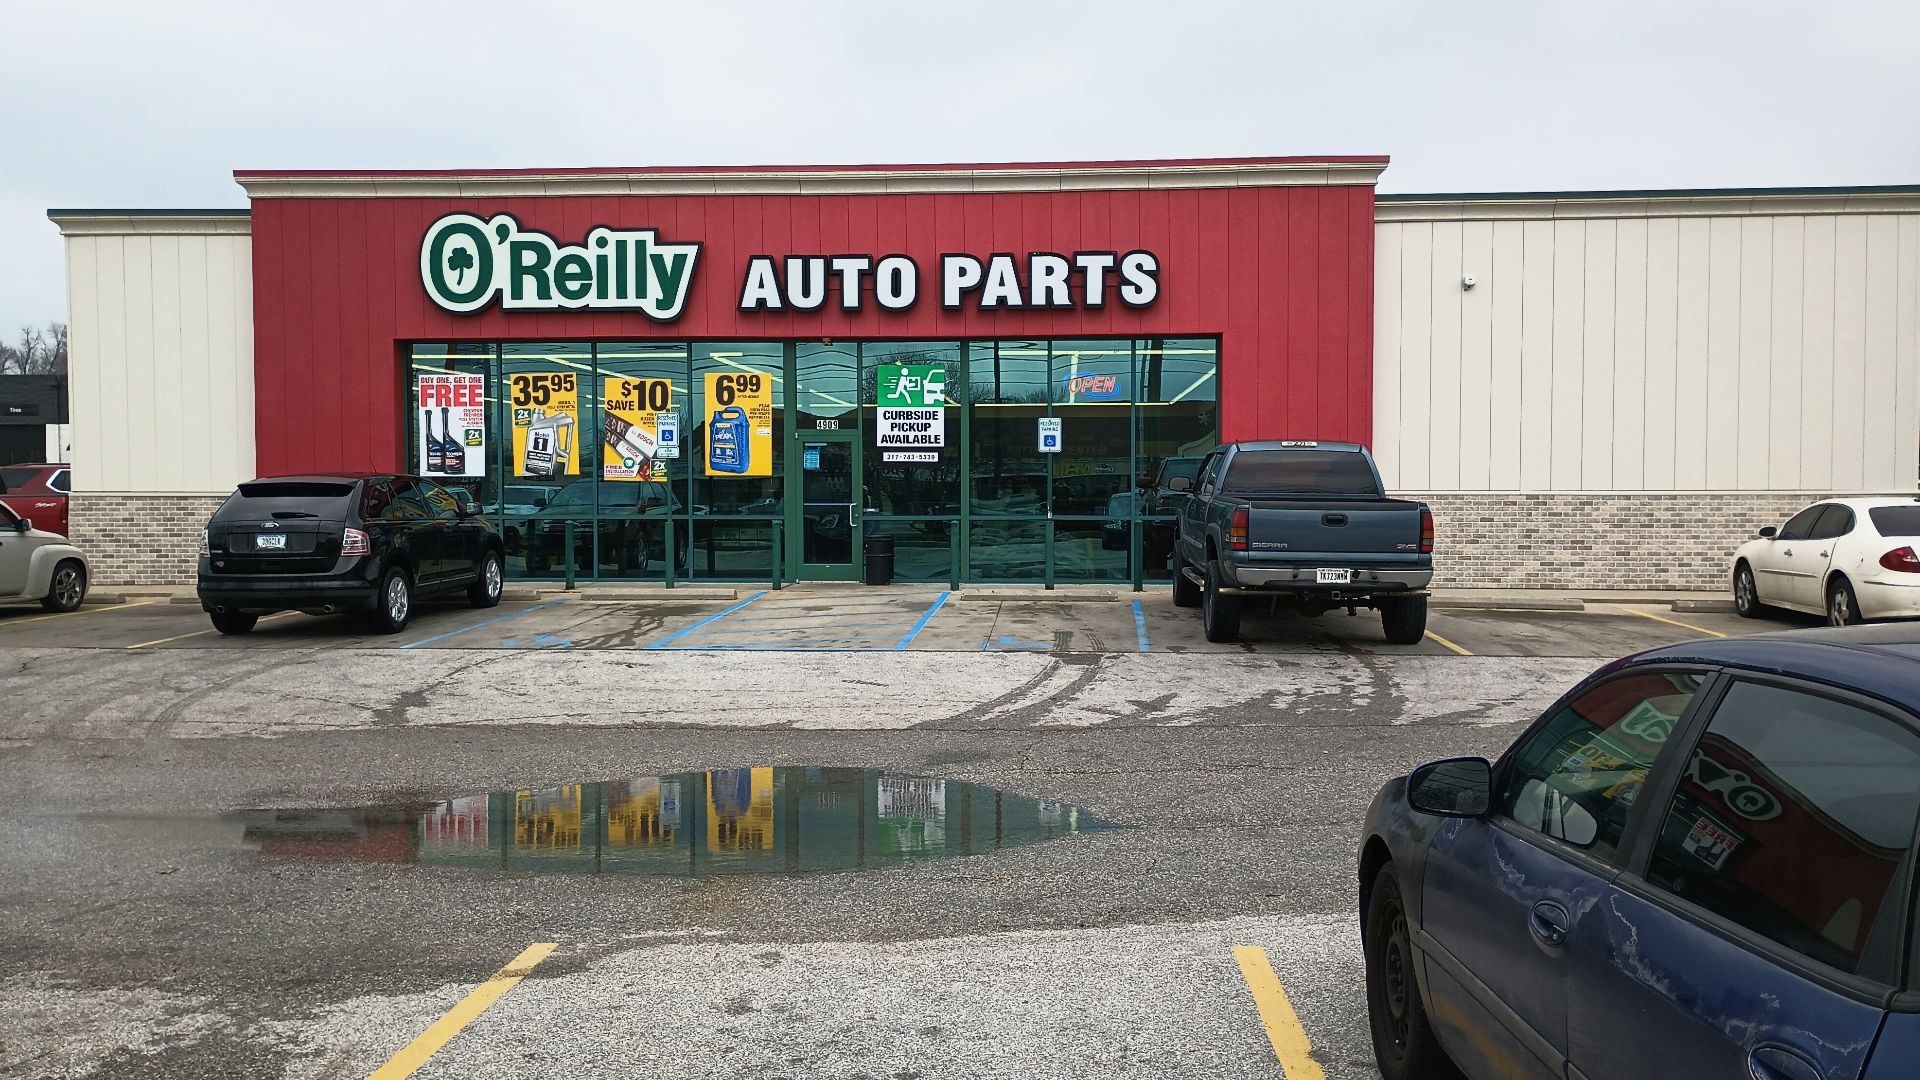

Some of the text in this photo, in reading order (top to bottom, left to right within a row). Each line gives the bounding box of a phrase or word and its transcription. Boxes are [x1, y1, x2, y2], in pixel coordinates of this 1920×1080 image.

[428, 222, 690, 311] O'Reilly
[739, 253, 1159, 309] AUTO PARTS
[420, 376, 435, 384] BUY
[453, 376, 467, 384] GET
[468, 376, 483, 384] ONE
[1068, 376, 1116, 394] OPEN
[420, 384, 484, 408] FREE
[606, 399, 635, 411] SAVE
[882, 410, 939, 421] CURBSIDE
[817, 420, 838, 429] 4909
[890, 422, 932, 432] PICKUP
[880, 434, 941, 444] AVAILABLE
